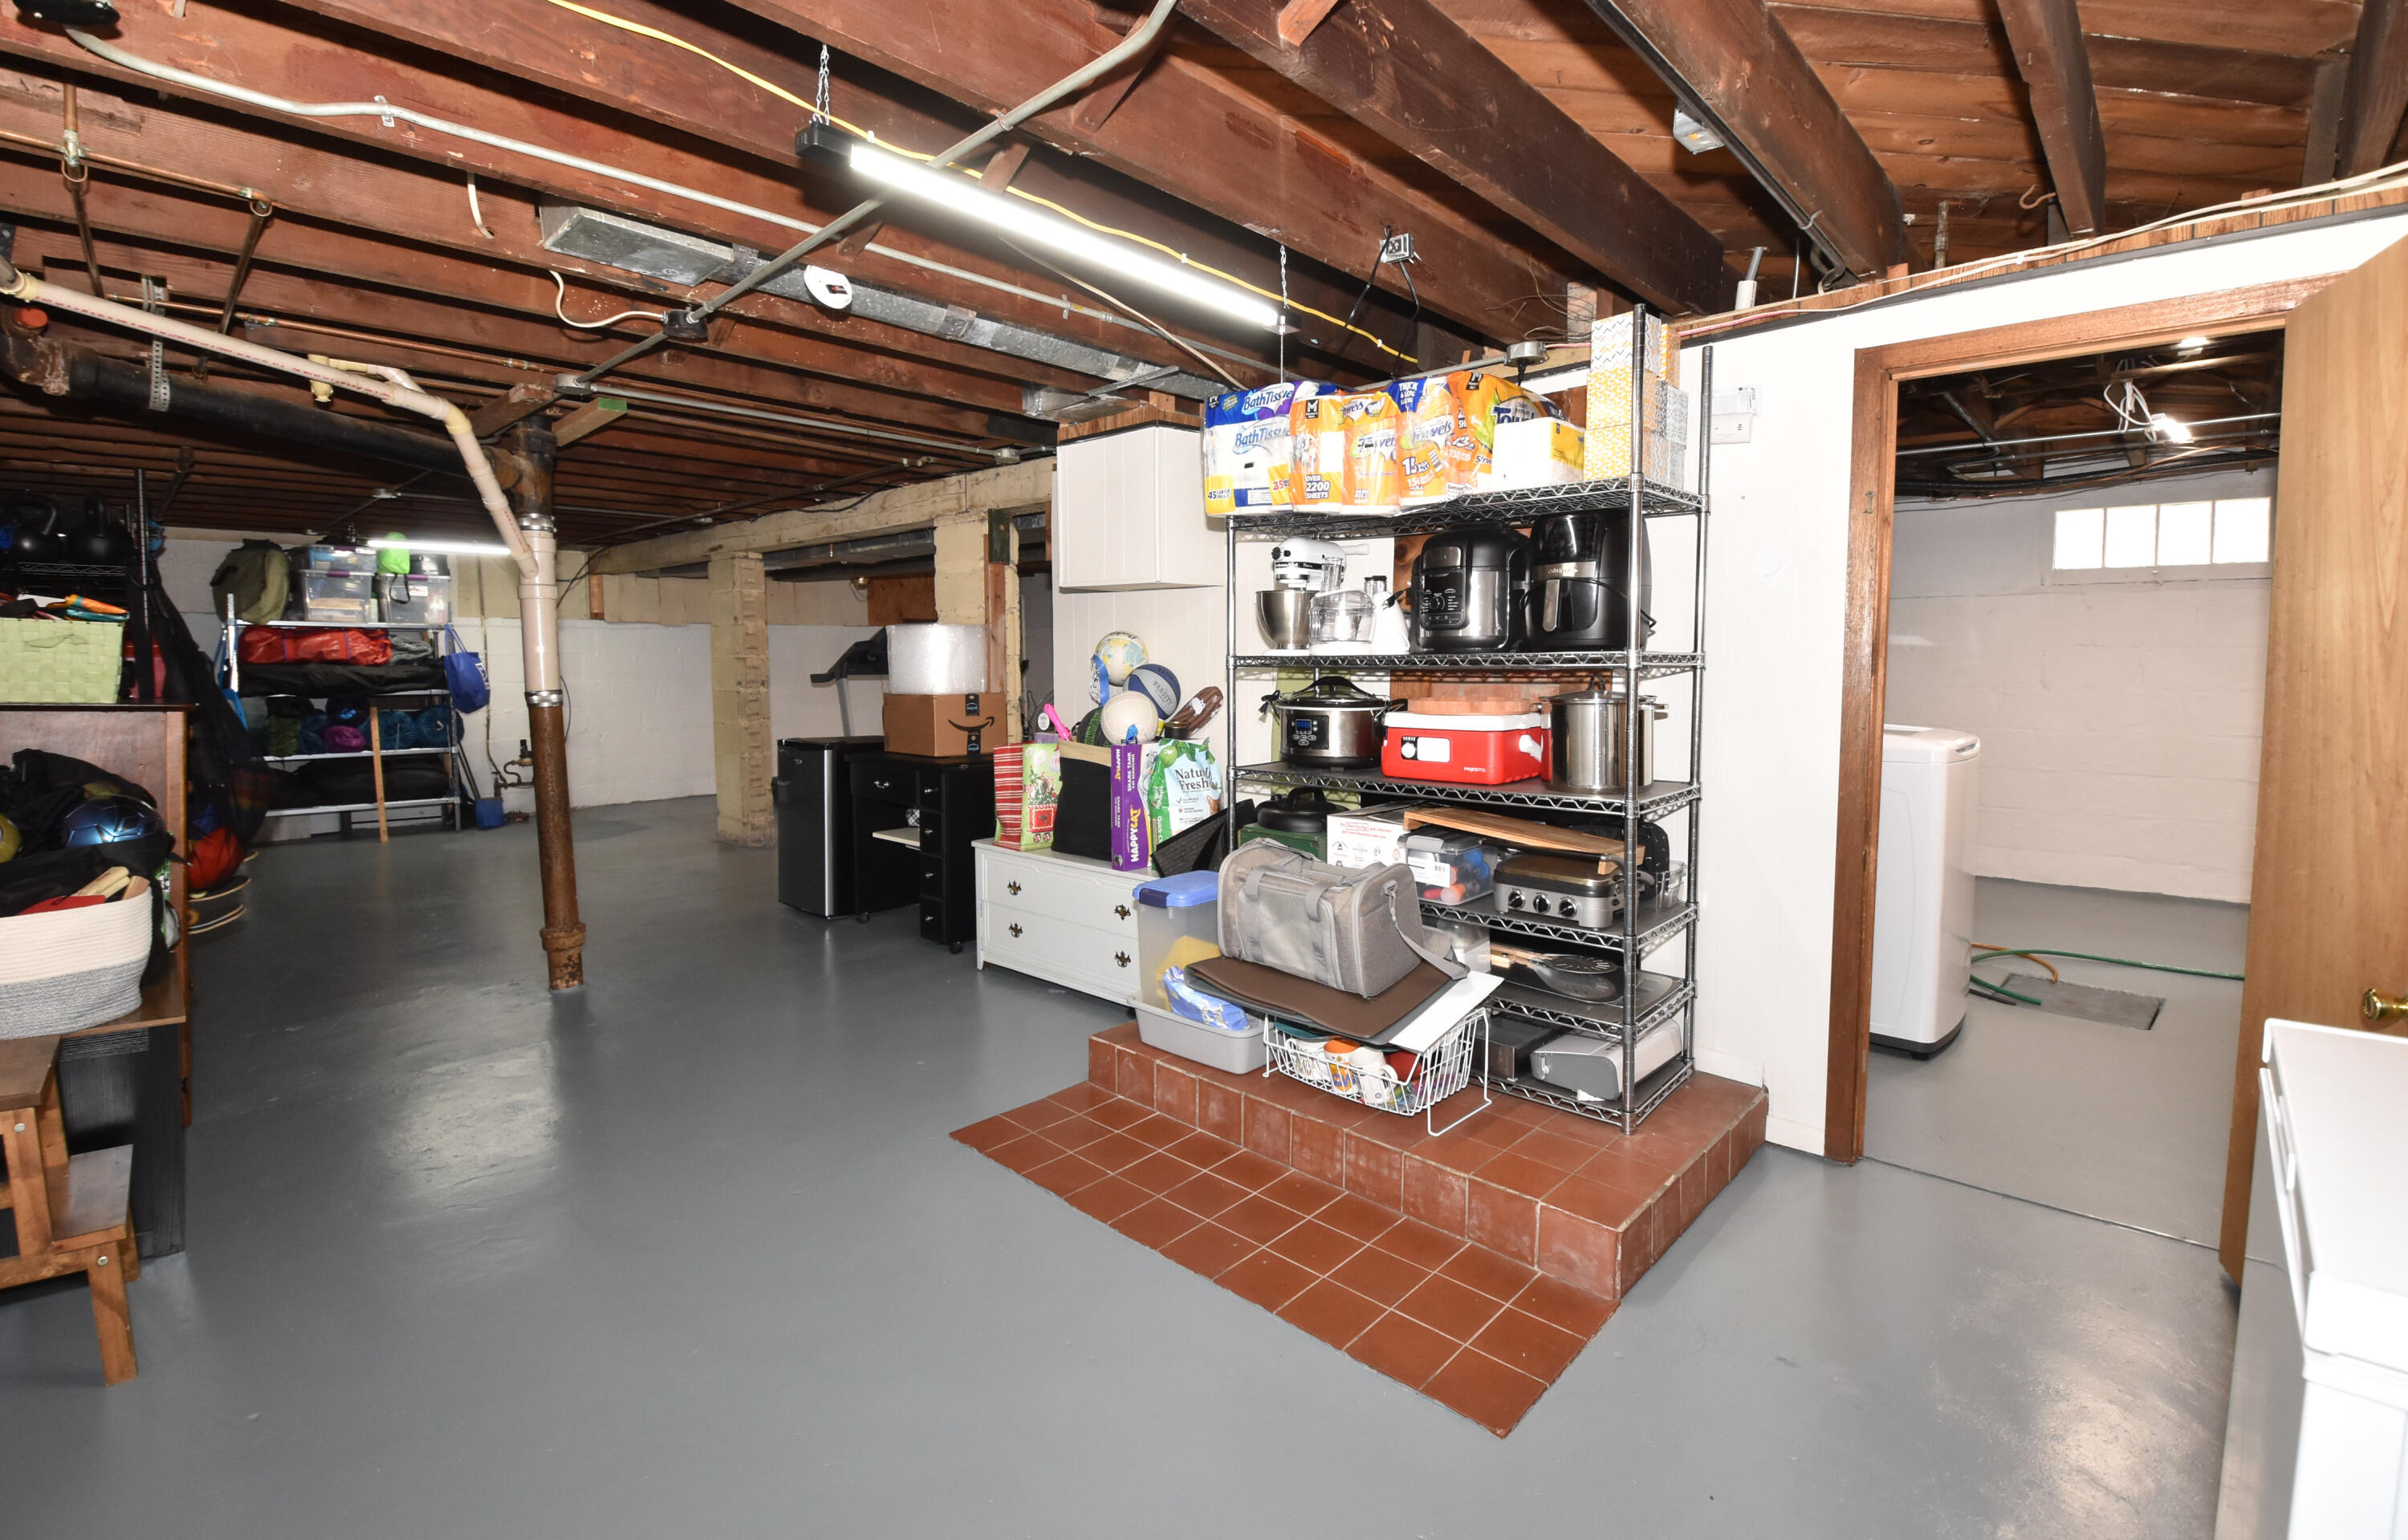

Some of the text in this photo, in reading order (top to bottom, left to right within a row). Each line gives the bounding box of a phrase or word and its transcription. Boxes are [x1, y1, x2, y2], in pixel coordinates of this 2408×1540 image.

[1399, 381, 1418, 391] THICK
[1305, 482, 1330, 492] 2200
[1208, 490, 1217, 499] 45
[1178, 778, 1210, 790] Fresh
